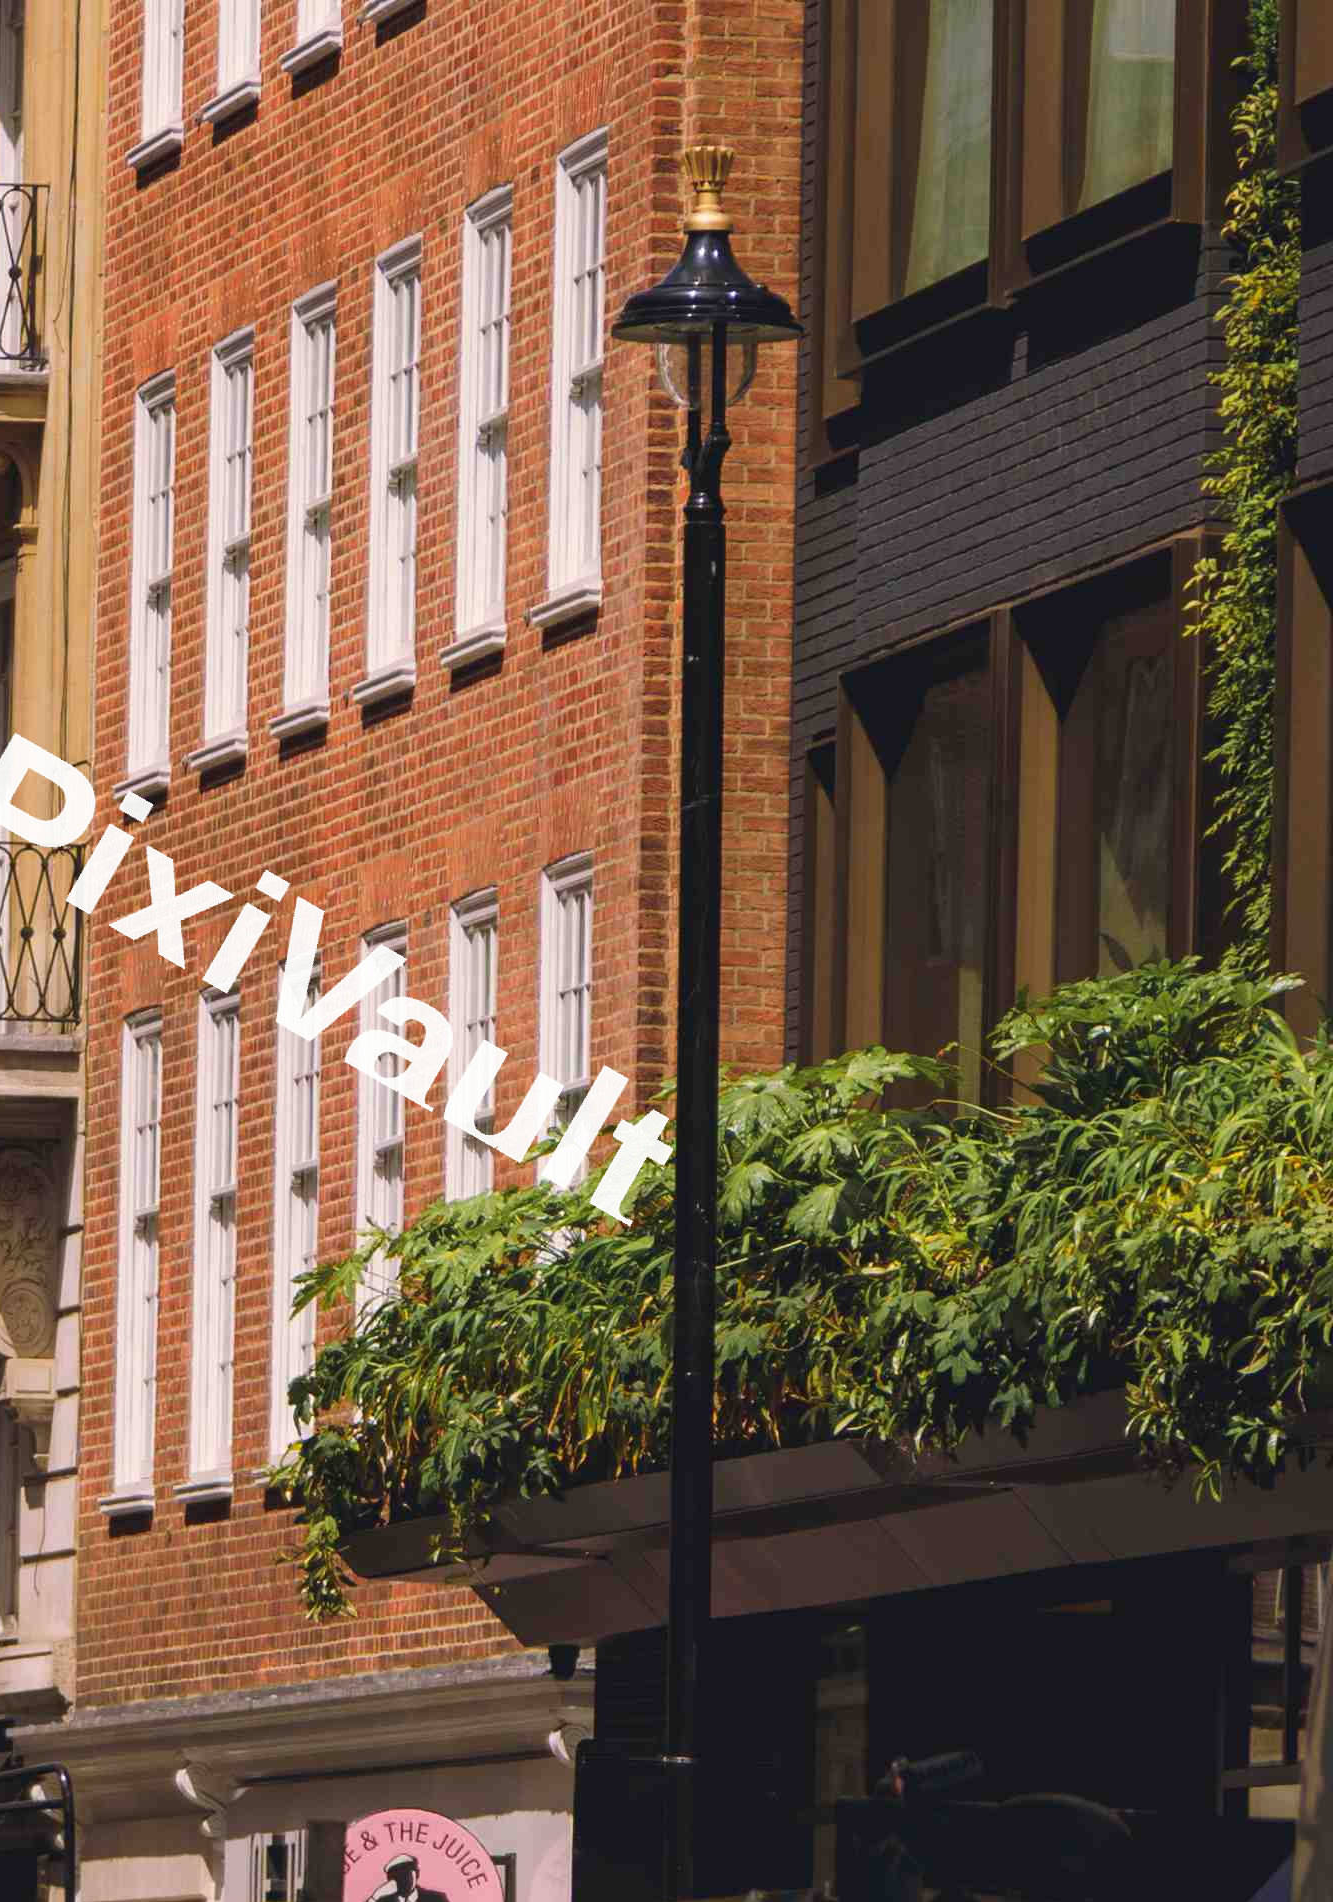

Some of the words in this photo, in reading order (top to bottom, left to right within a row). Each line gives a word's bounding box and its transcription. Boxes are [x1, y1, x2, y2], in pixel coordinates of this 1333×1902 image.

[360, 1831, 378, 1852] &
[384, 1821, 430, 1844] THE
[433, 1833, 489, 1889] JUICE
